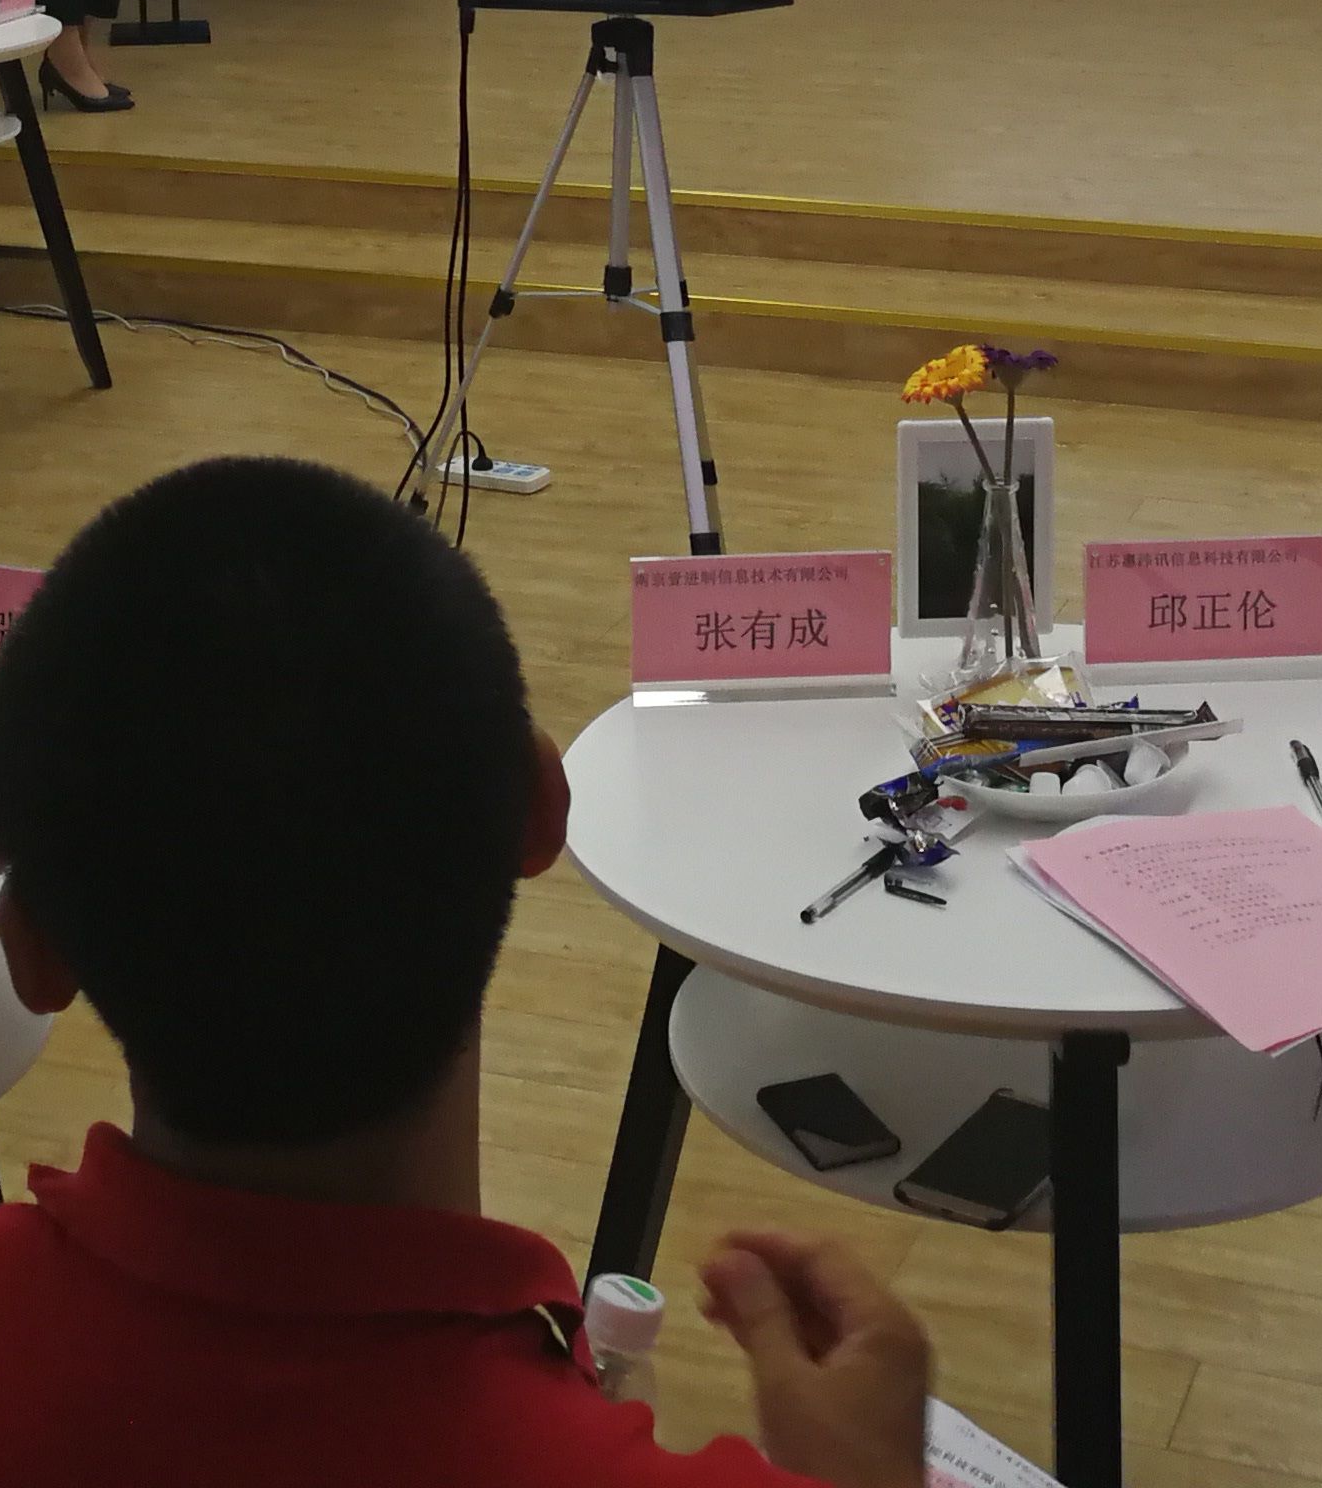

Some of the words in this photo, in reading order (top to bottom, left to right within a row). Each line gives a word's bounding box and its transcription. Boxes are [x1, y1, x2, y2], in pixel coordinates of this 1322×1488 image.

[695, 608, 830, 652] 张有成
[1149, 589, 1277, 634] 邱正伦
